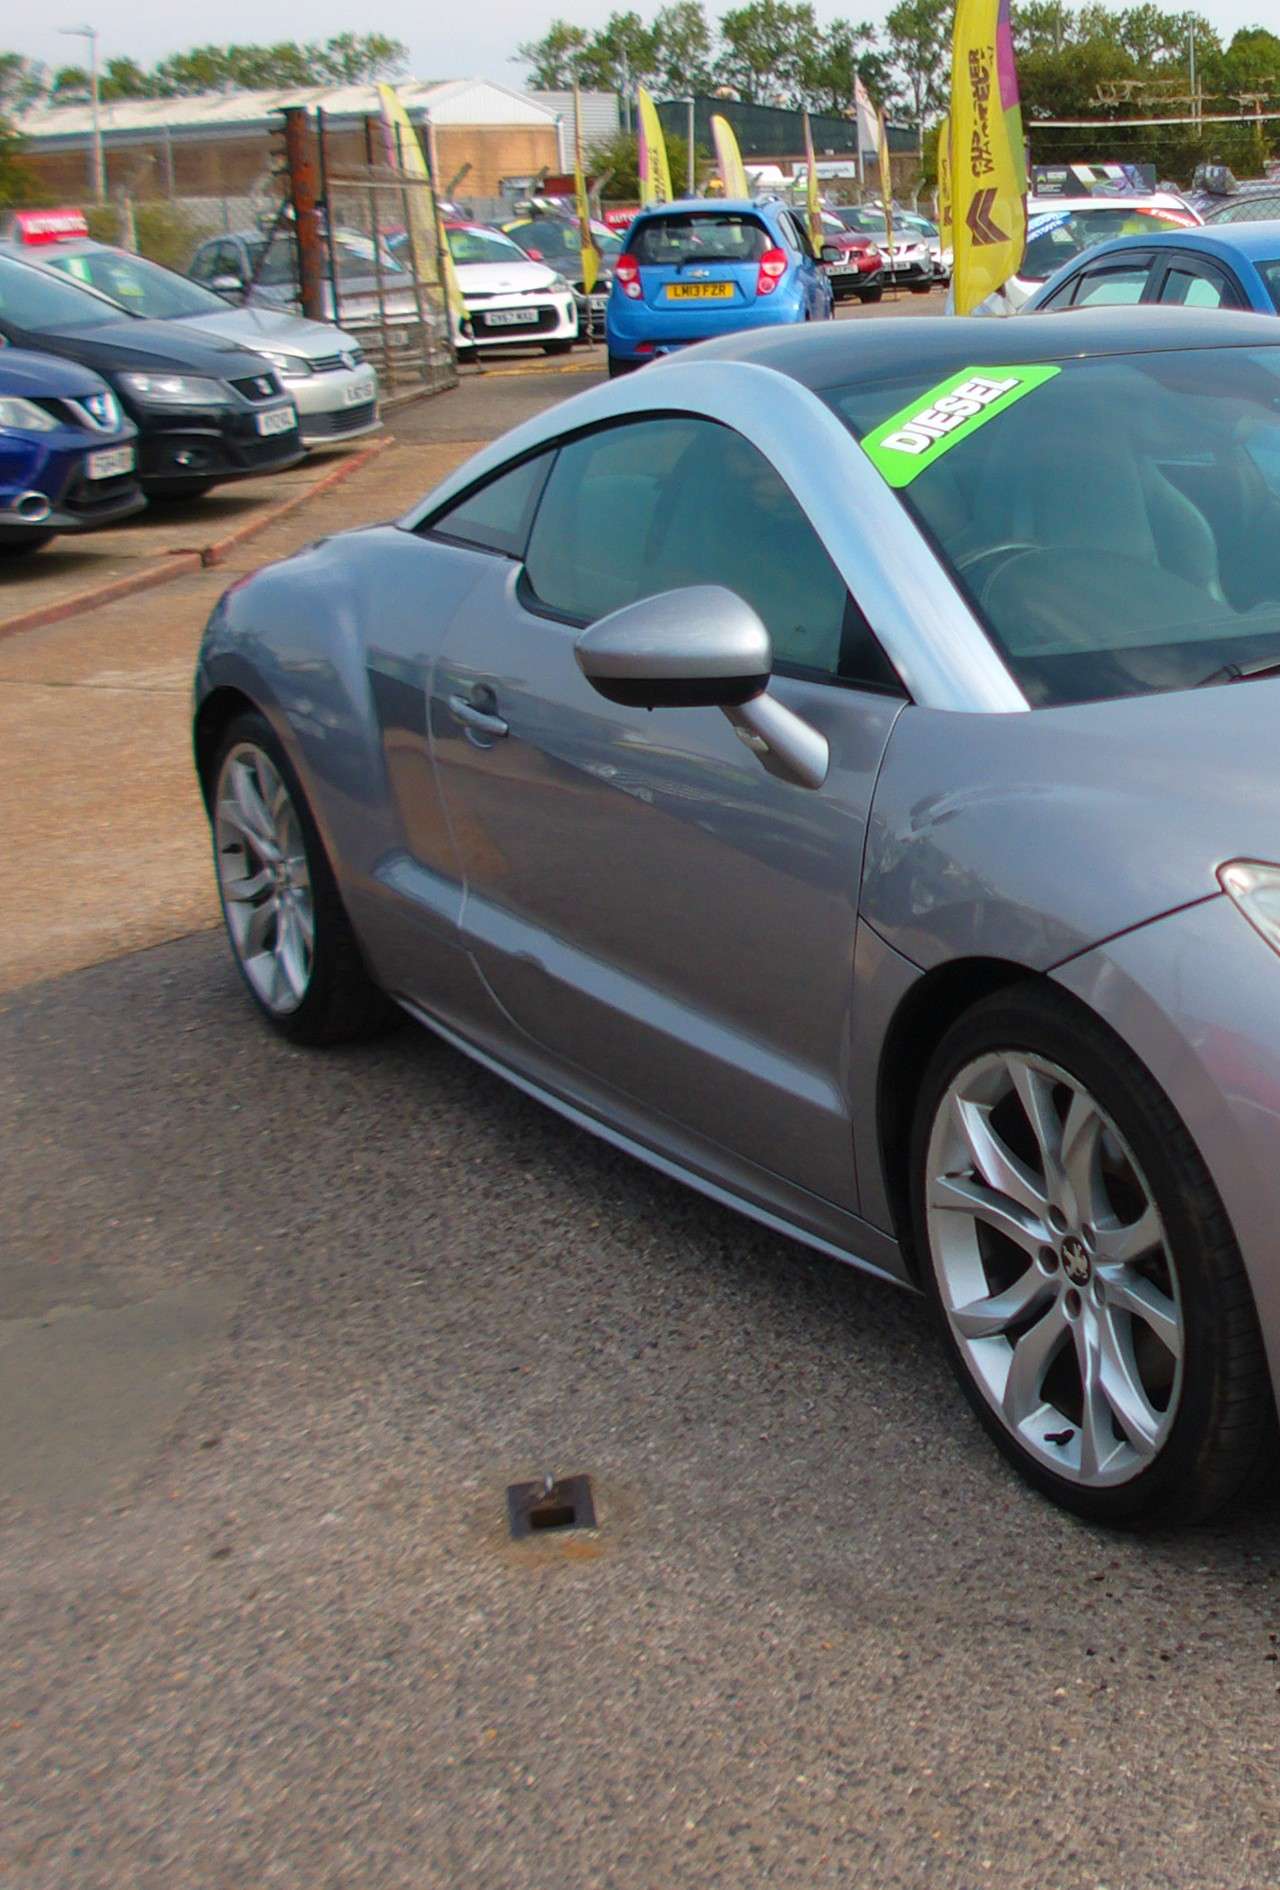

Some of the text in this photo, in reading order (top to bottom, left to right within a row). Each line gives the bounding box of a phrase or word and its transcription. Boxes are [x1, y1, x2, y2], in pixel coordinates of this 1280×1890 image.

[674, 283, 726, 296] LM13 FZR
[879, 376, 1025, 455] DIESEL
